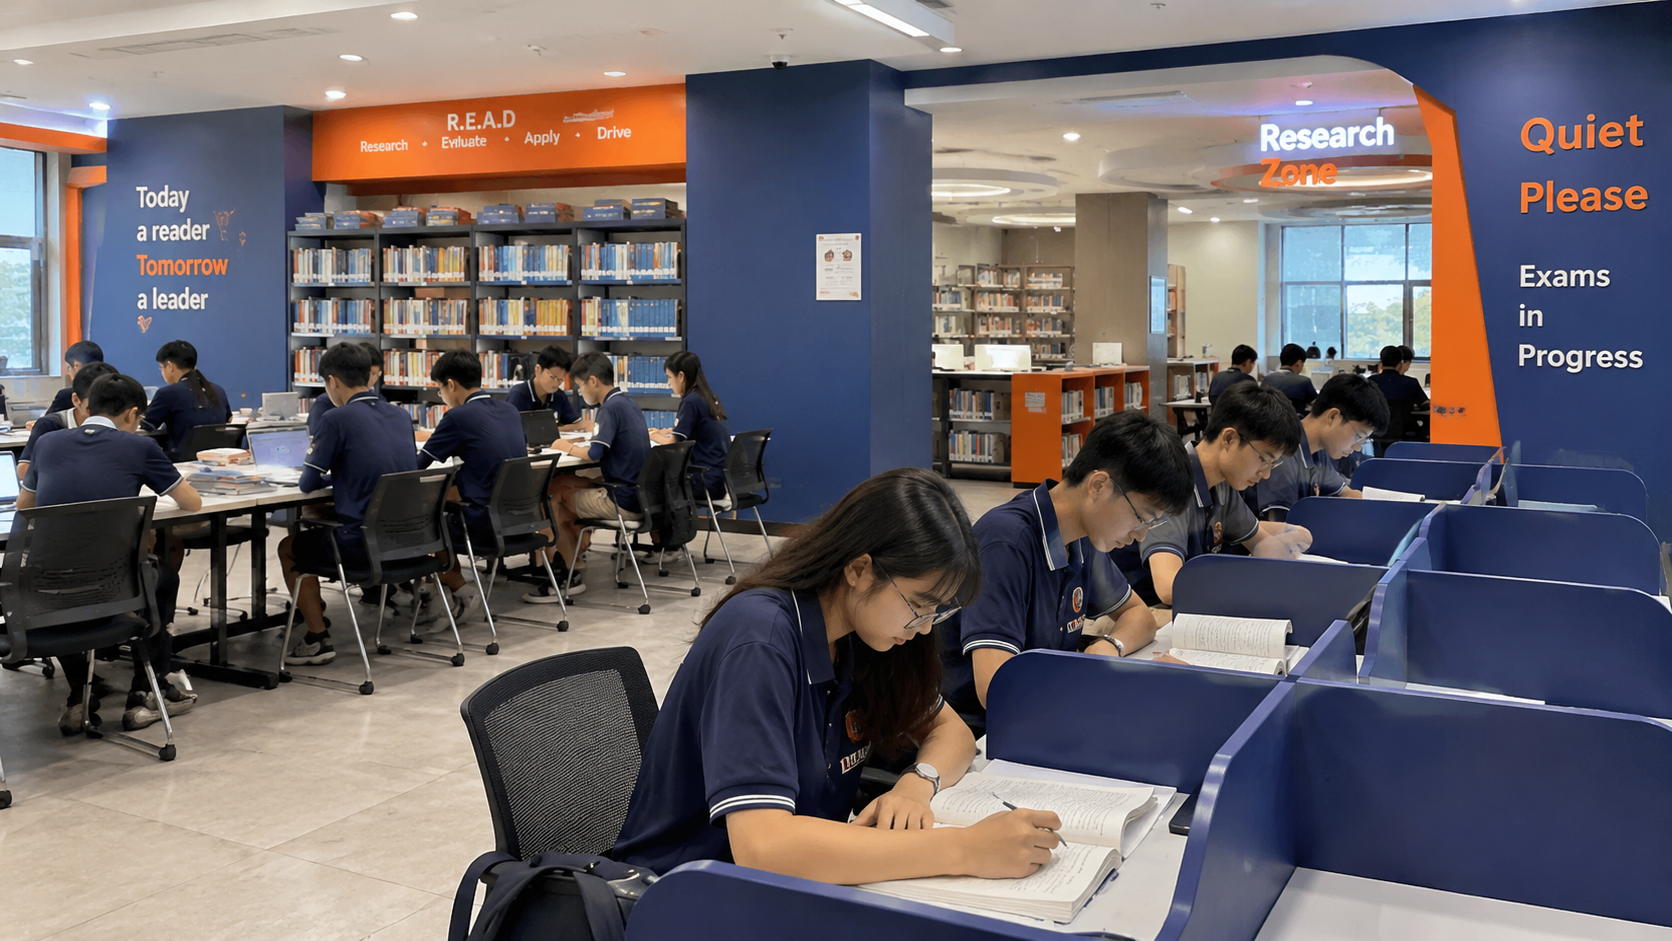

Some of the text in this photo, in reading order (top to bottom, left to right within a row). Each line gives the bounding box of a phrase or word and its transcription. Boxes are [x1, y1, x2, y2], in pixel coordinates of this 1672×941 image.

[447, 109, 516, 131] R.E.A.D
[1260, 116, 1395, 152] Research
[1520, 113, 1644, 155] Quiet
[360, 138, 409, 153] Research
[524, 129, 561, 146] Apply
[597, 125, 632, 140] Drive
[1260, 157, 1338, 187] Zone
[136, 184, 190, 213] Today
[1520, 180, 1648, 214] Please
[136, 218, 211, 242] a reader
[136, 254, 229, 276] Tomorrow
[1519, 264, 1611, 288] Exams
[137, 286, 209, 310] a leader
[1518, 303, 1543, 327] in
[1518, 344, 1644, 373] Progress
